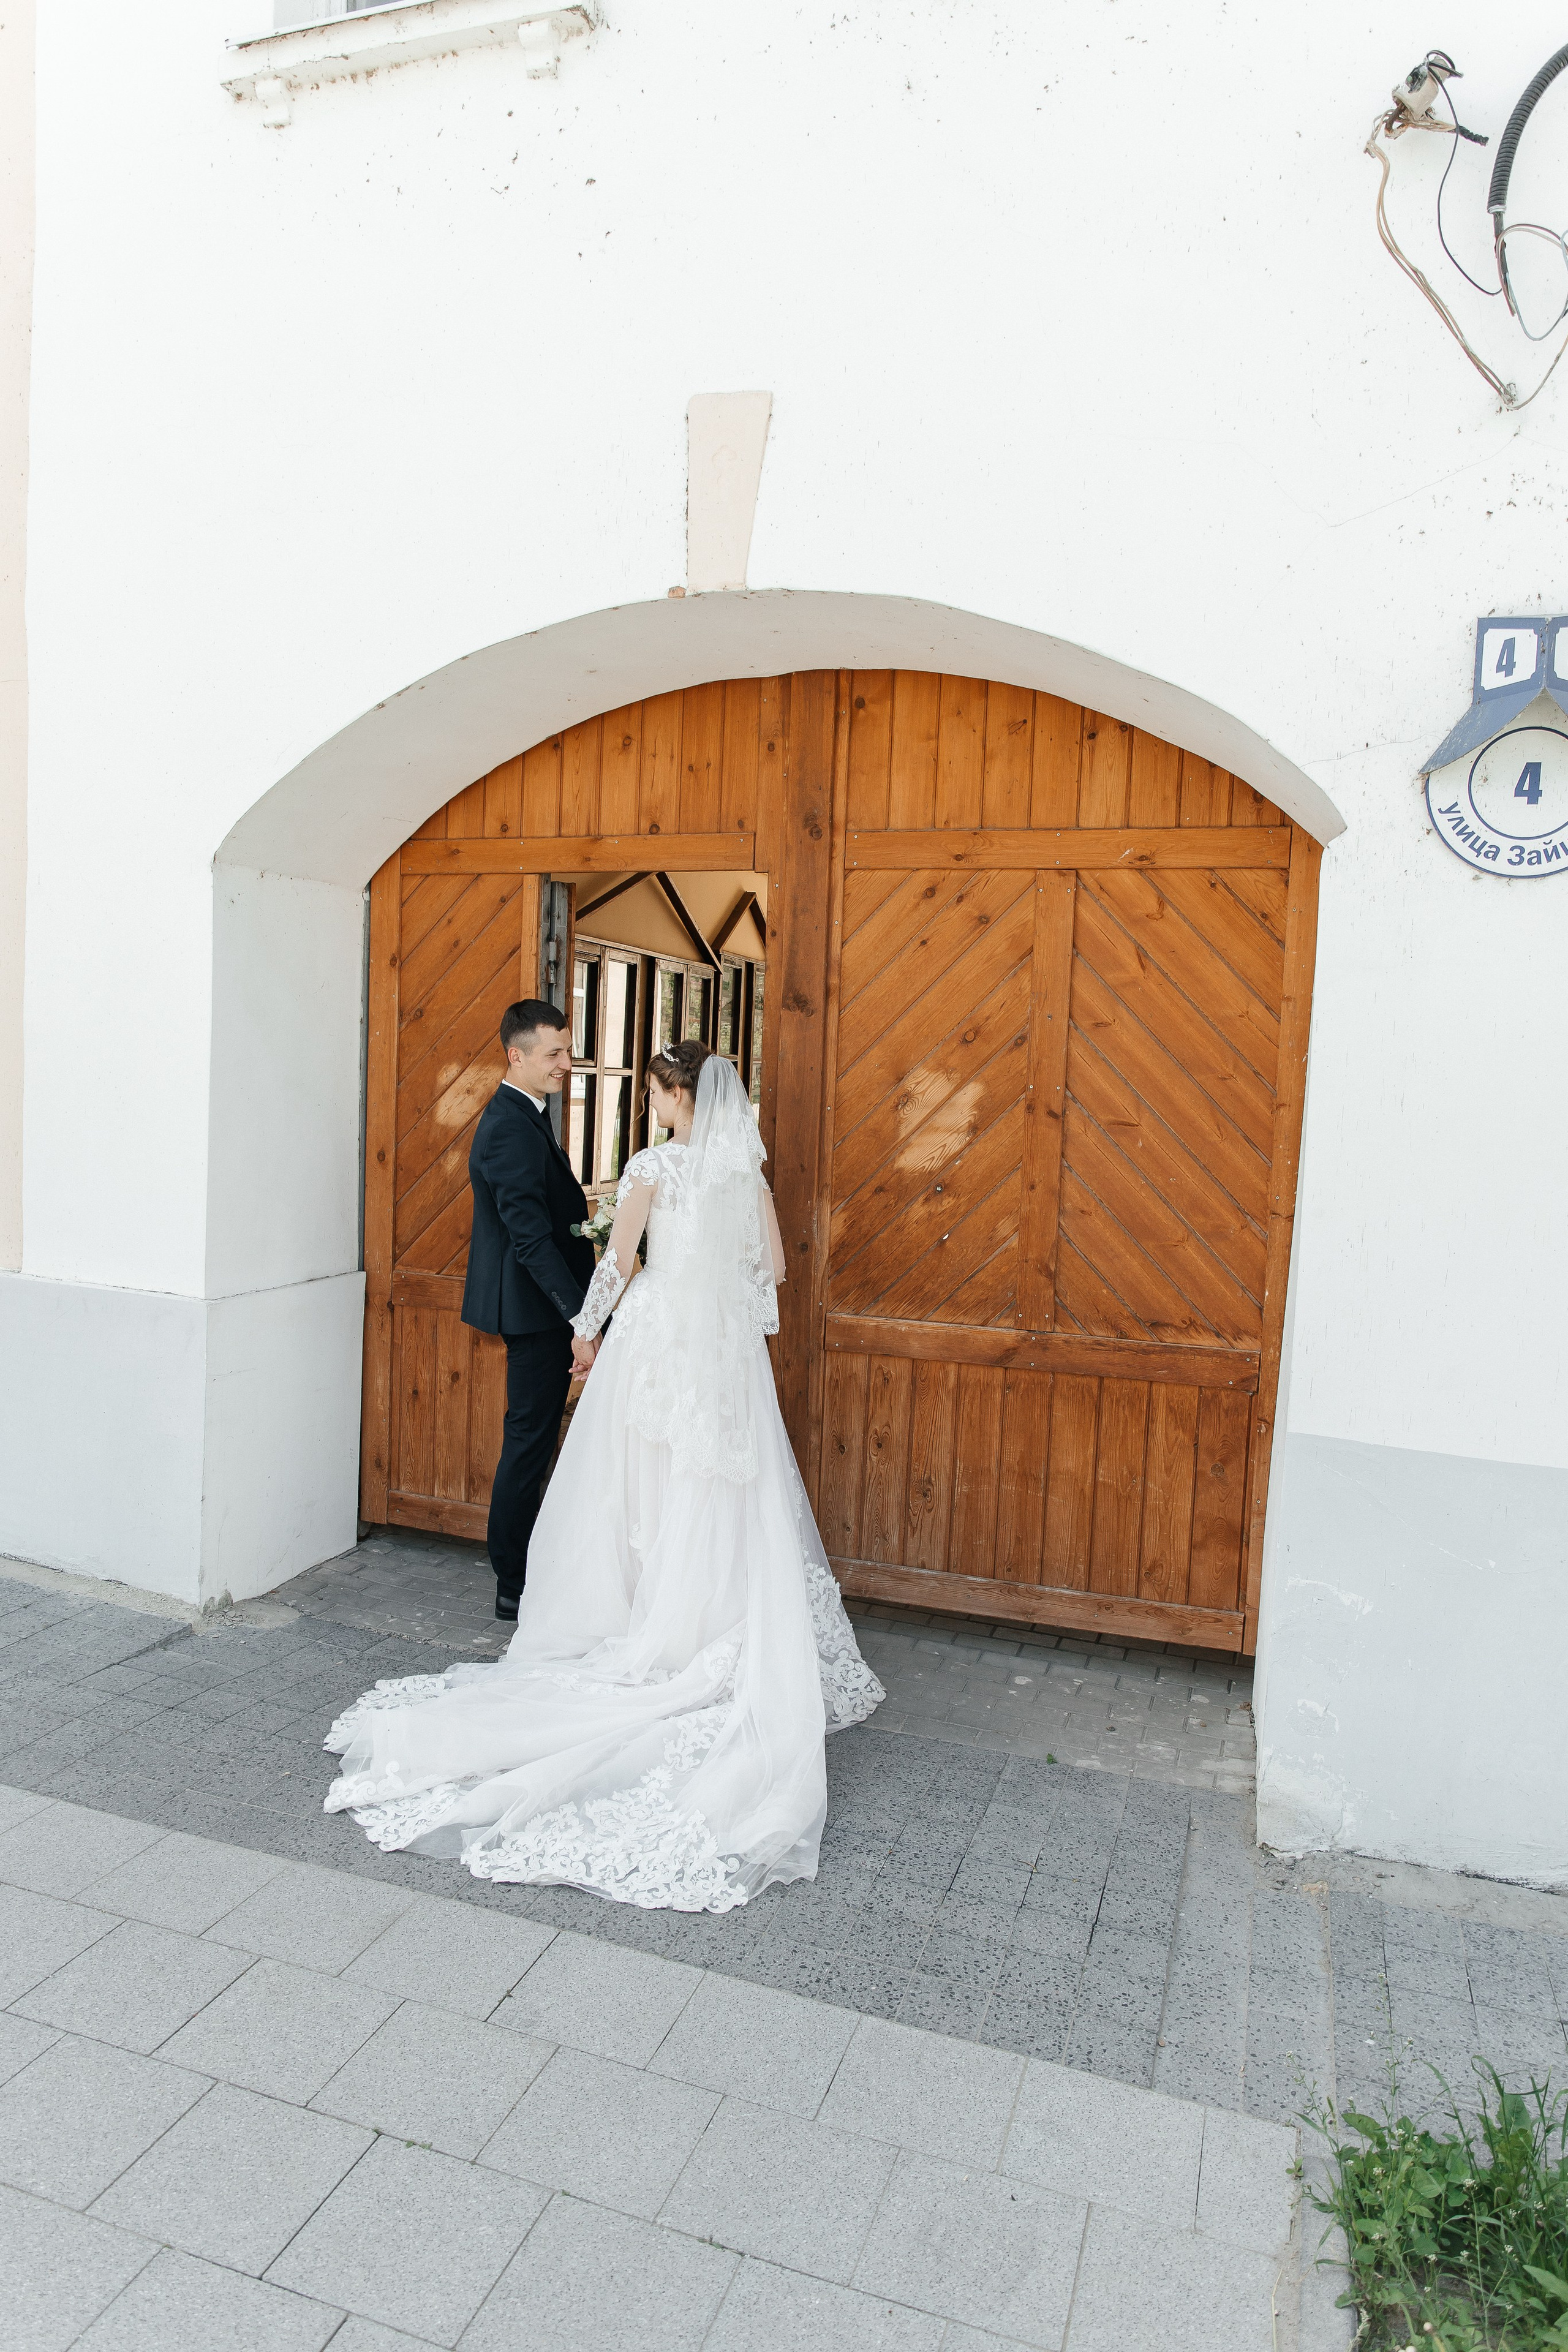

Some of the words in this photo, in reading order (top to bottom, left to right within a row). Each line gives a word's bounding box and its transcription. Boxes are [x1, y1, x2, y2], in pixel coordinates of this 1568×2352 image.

[1496, 637, 1516, 677] 4
[1514, 762, 1542, 805] 4
[1438, 801, 1501, 861] улица
